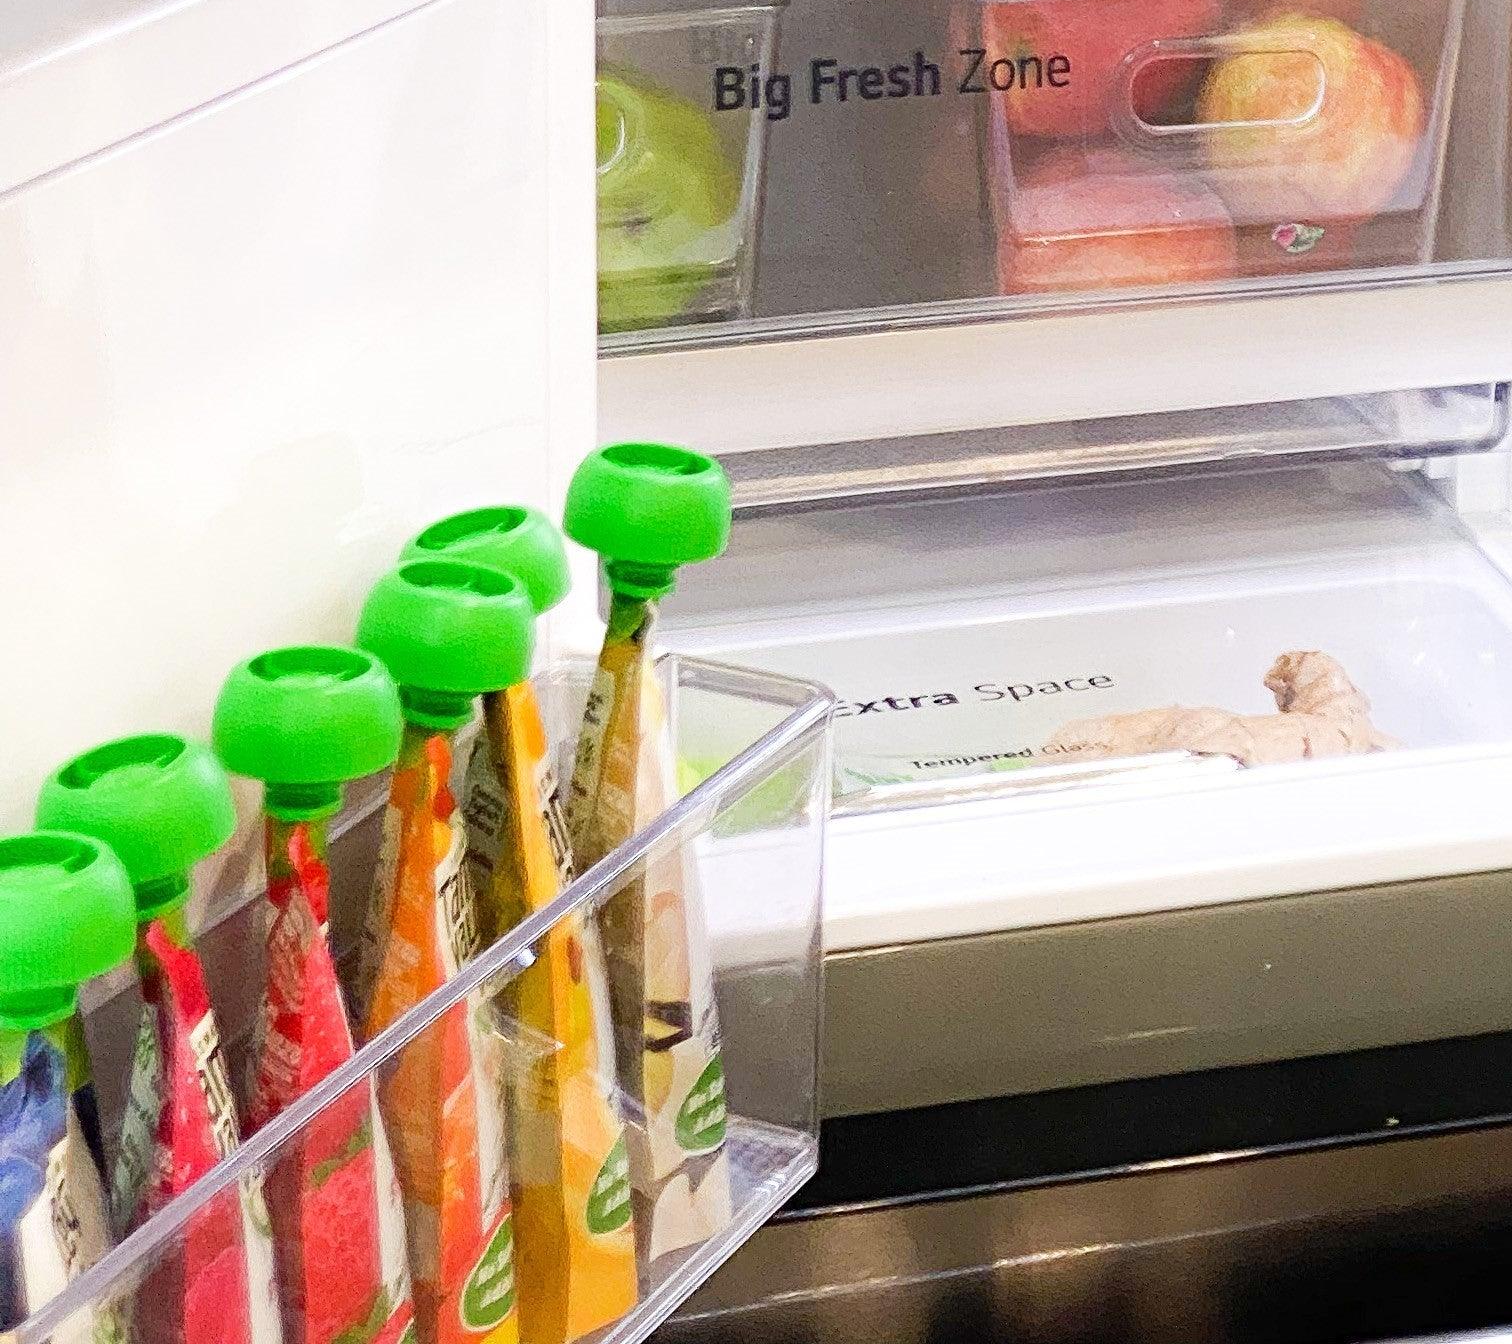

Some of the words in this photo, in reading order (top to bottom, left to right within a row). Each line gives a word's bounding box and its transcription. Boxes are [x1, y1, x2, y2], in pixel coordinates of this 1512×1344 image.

[713, 63, 792, 122] Big
[808, 49, 942, 104] Fresh
[958, 47, 1072, 95] Zone
[973, 674, 1115, 703] Space
[912, 746, 1036, 771] Tempered
[1040, 740, 1116, 757] Glass
